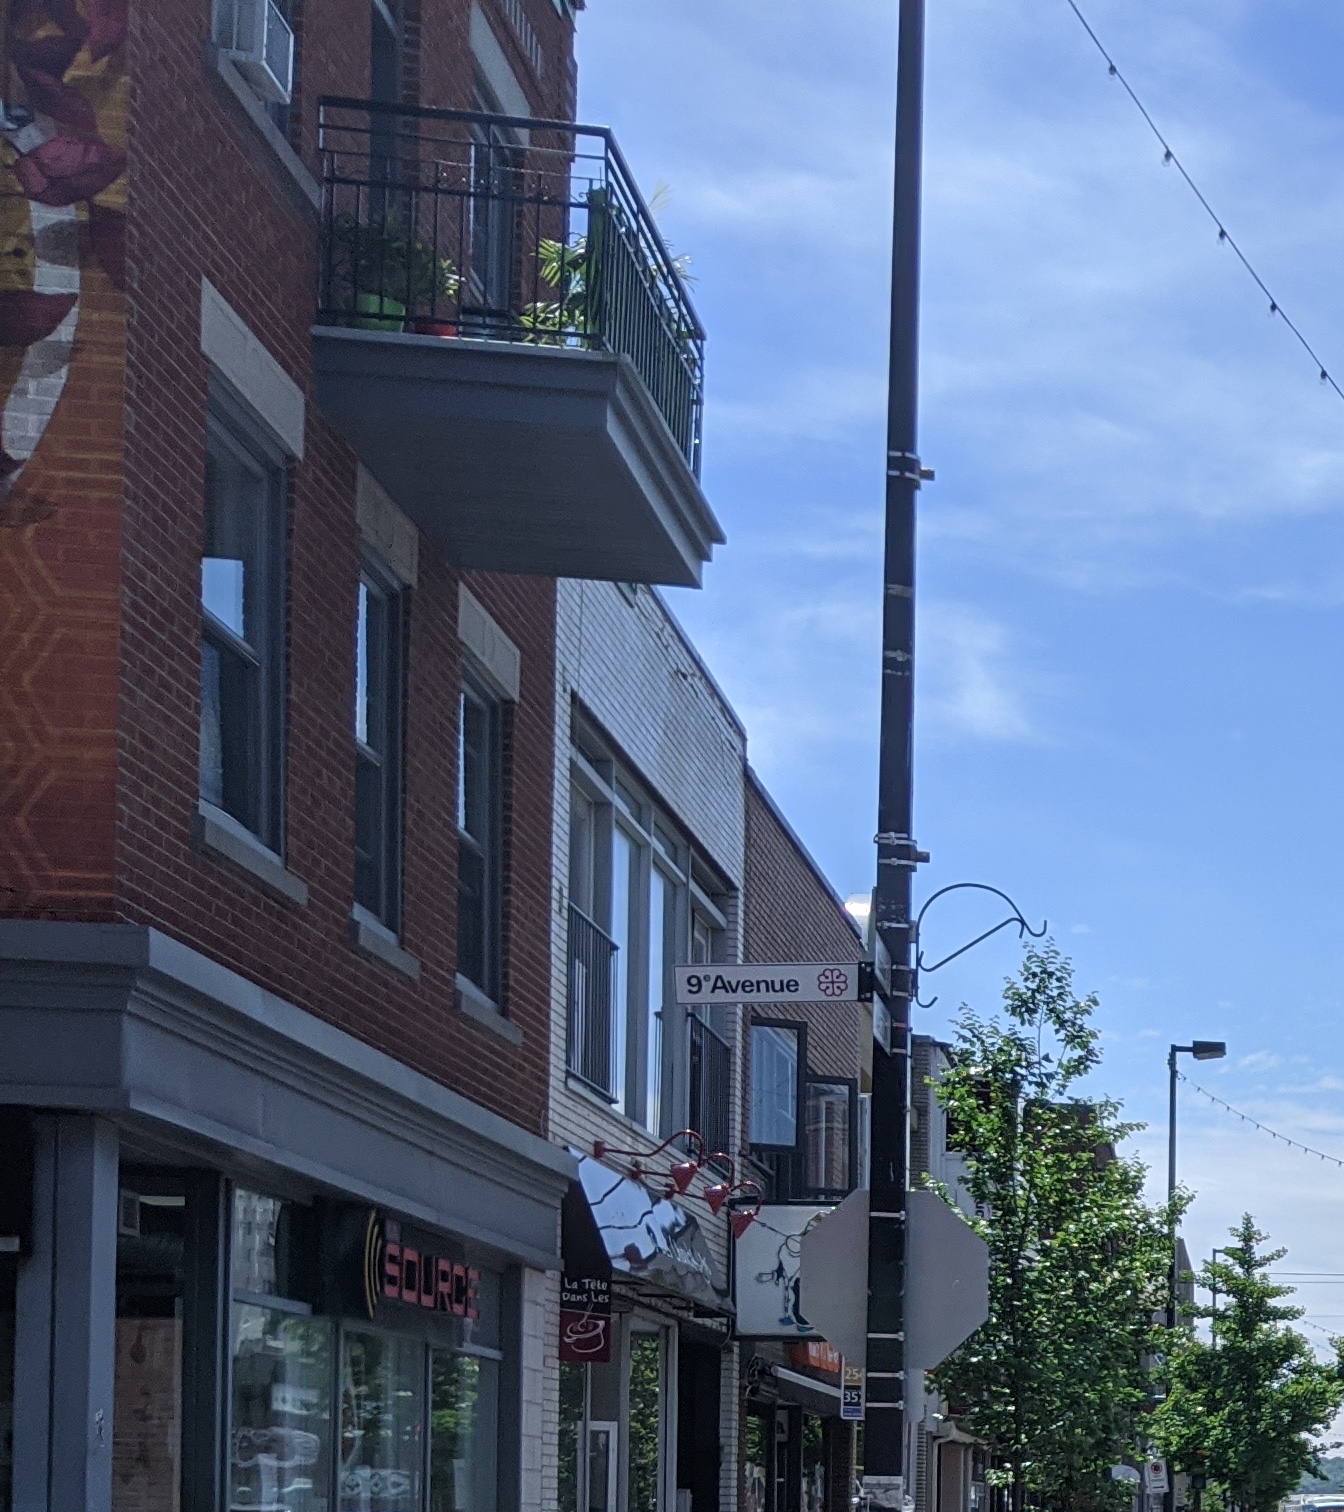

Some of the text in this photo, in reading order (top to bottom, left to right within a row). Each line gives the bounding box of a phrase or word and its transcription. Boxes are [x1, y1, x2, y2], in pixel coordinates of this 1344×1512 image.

[710, 974, 800, 995] Avenue
[384, 1242, 480, 1321] SOURCE
[564, 1277, 579, 1290] La
[562, 1290, 610, 1304] Dans Les
[845, 1367, 863, 1380] 25
[844, 1391, 862, 1403] 35
